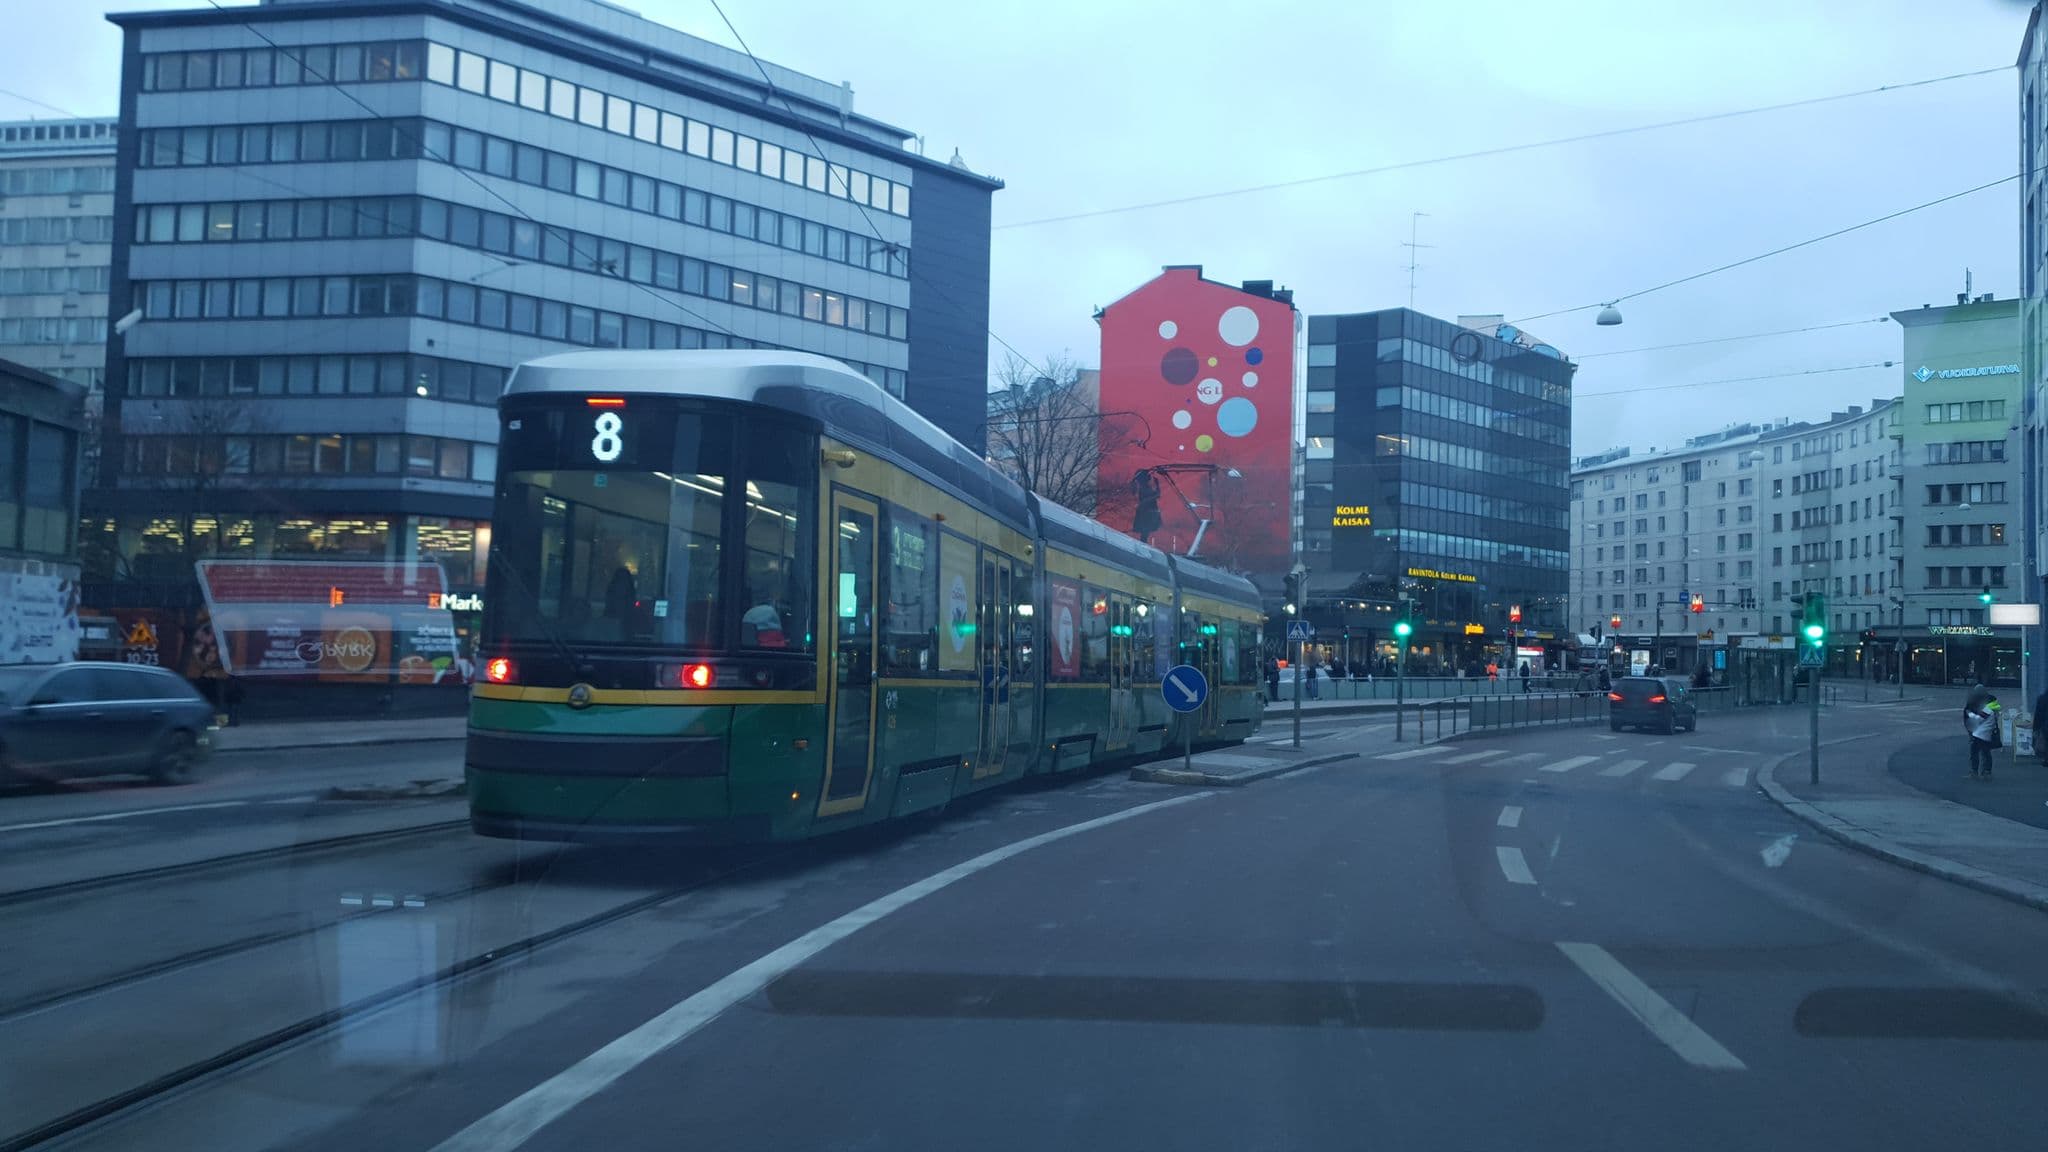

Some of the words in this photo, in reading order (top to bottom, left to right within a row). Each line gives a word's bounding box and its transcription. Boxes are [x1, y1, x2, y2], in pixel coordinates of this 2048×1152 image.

[1938, 364, 2020, 379] VUOKRATURVA
[592, 412, 622, 461] 8
[1336, 505, 1369, 515] KOLME
[1333, 517, 1371, 526] KAISAA
